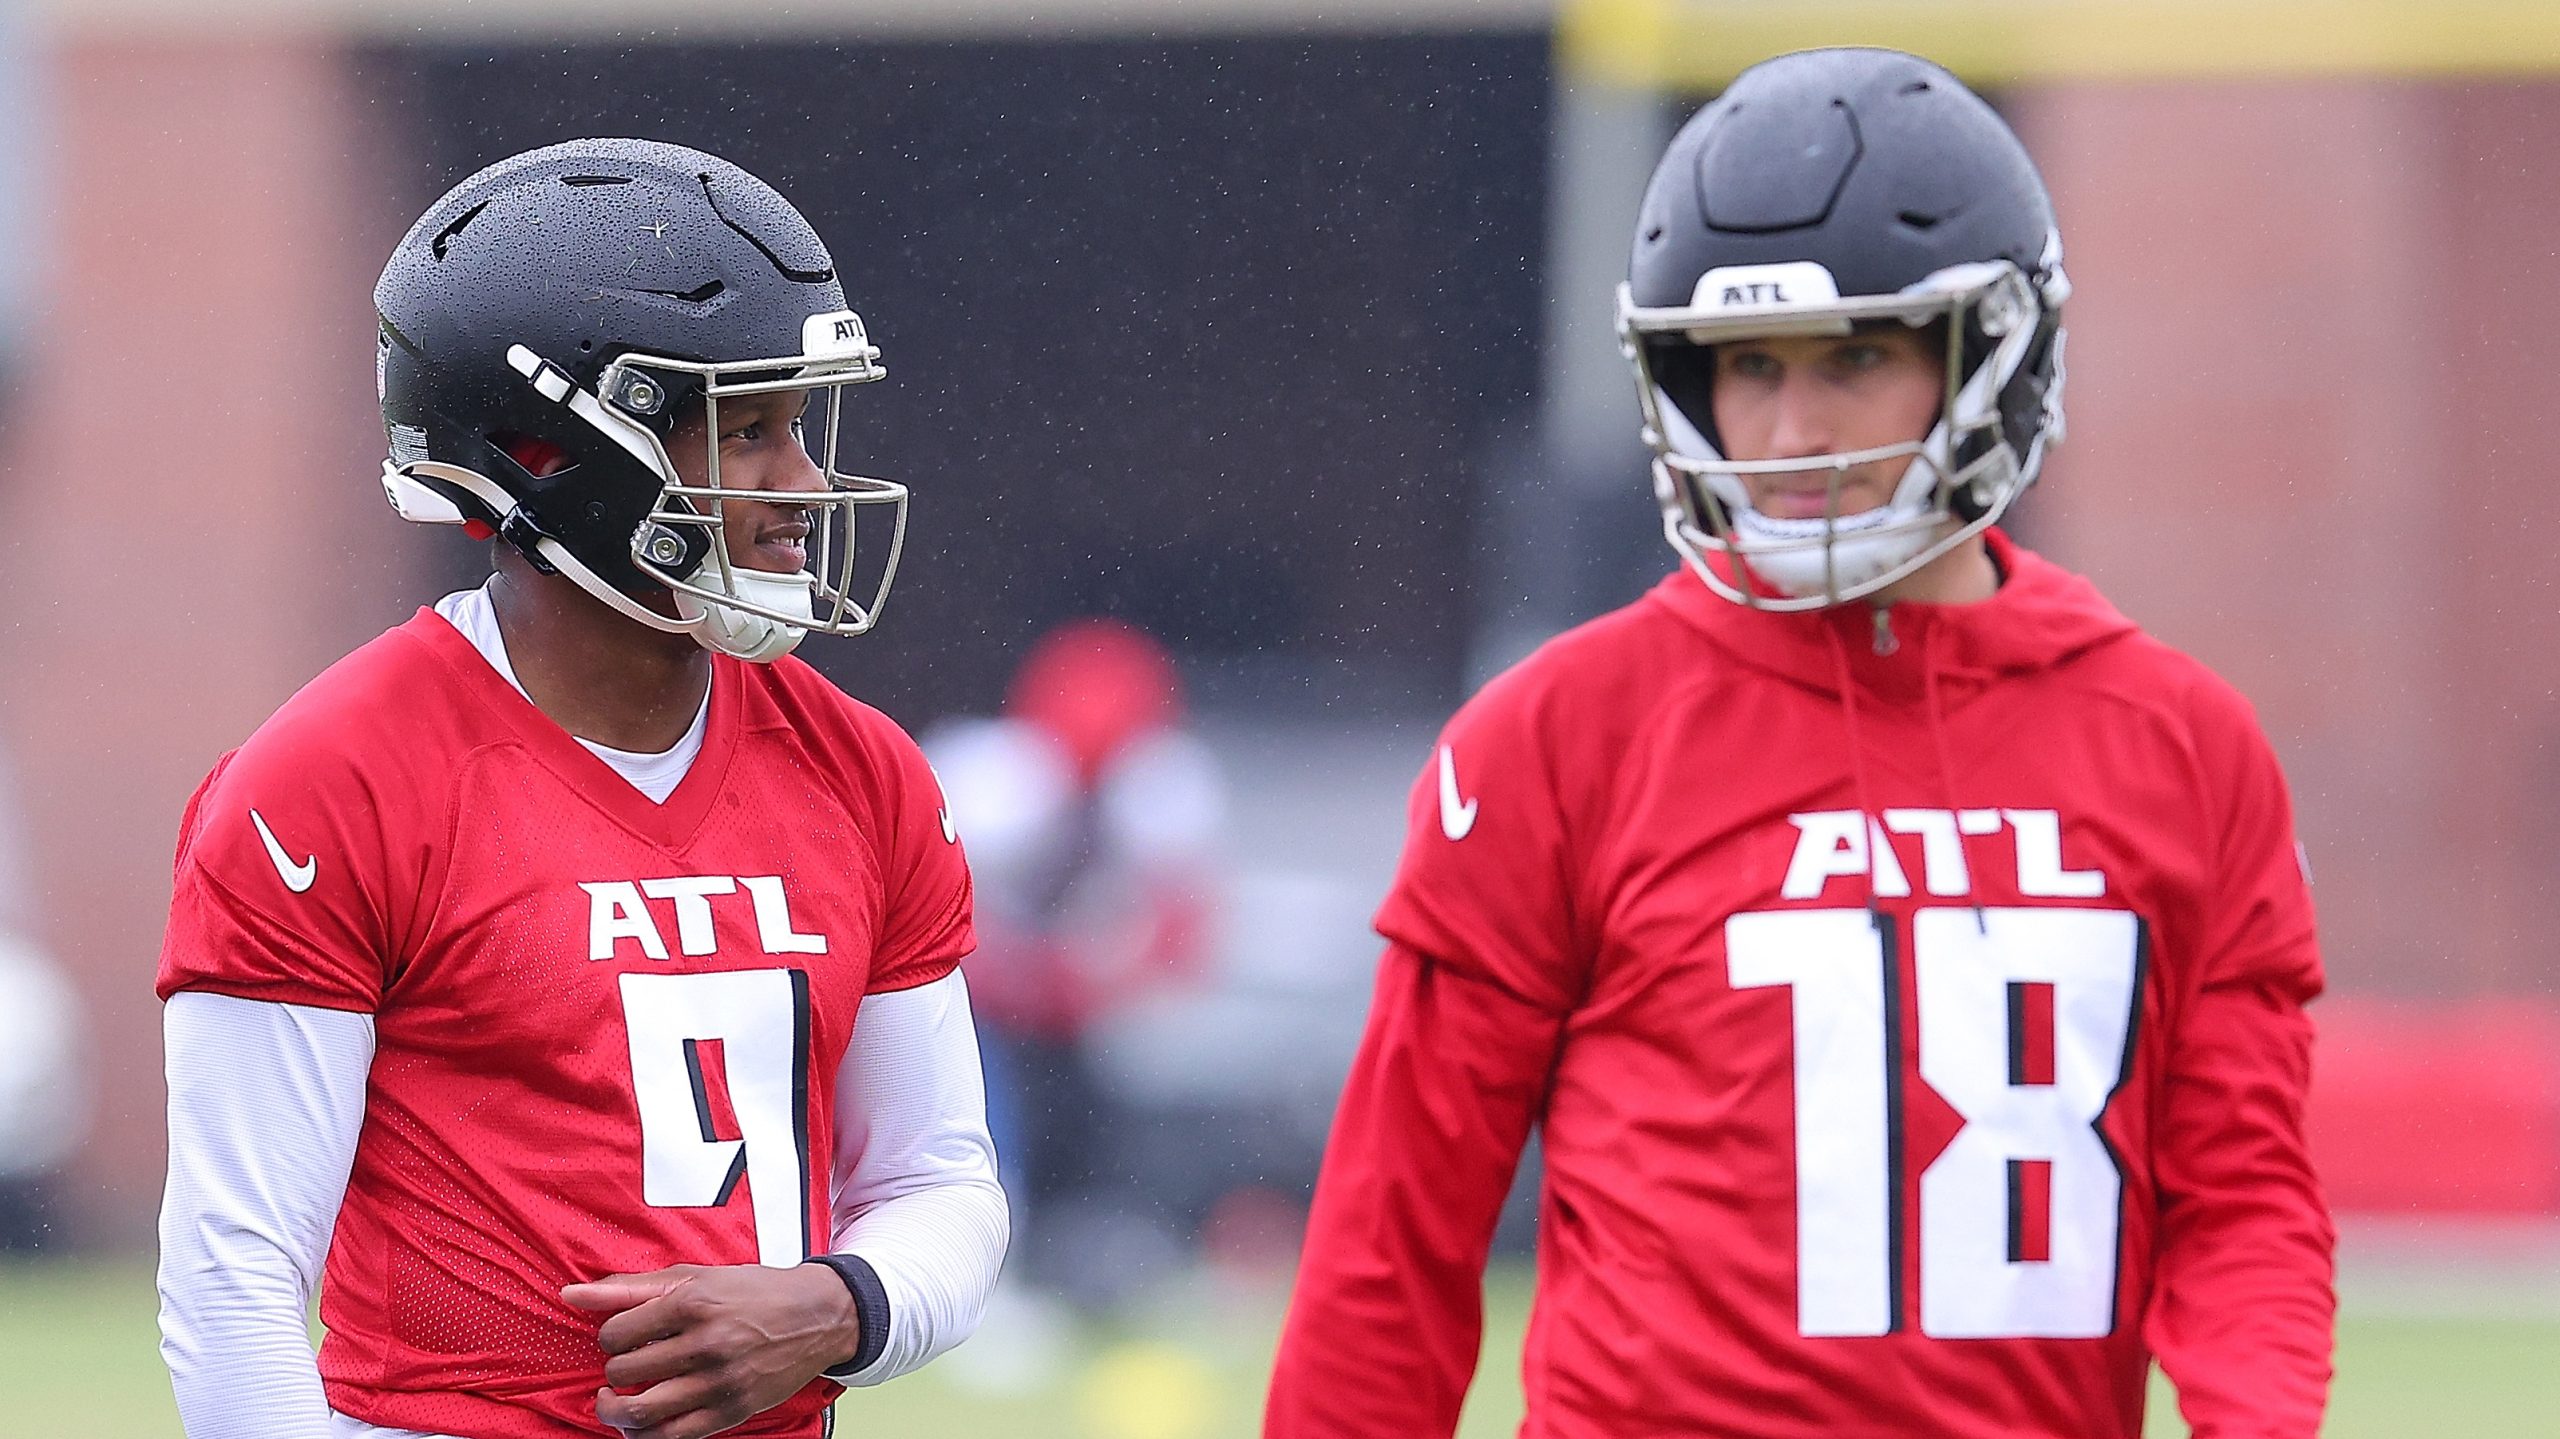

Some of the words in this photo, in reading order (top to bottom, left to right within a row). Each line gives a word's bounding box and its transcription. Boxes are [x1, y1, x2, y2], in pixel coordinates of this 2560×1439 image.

[1724, 283, 1789, 305] ATL
[1780, 808, 2106, 900] ATL
[577, 875, 828, 961] ATL
[618, 968, 811, 1269] 9
[1724, 906, 2148, 1339] 18
